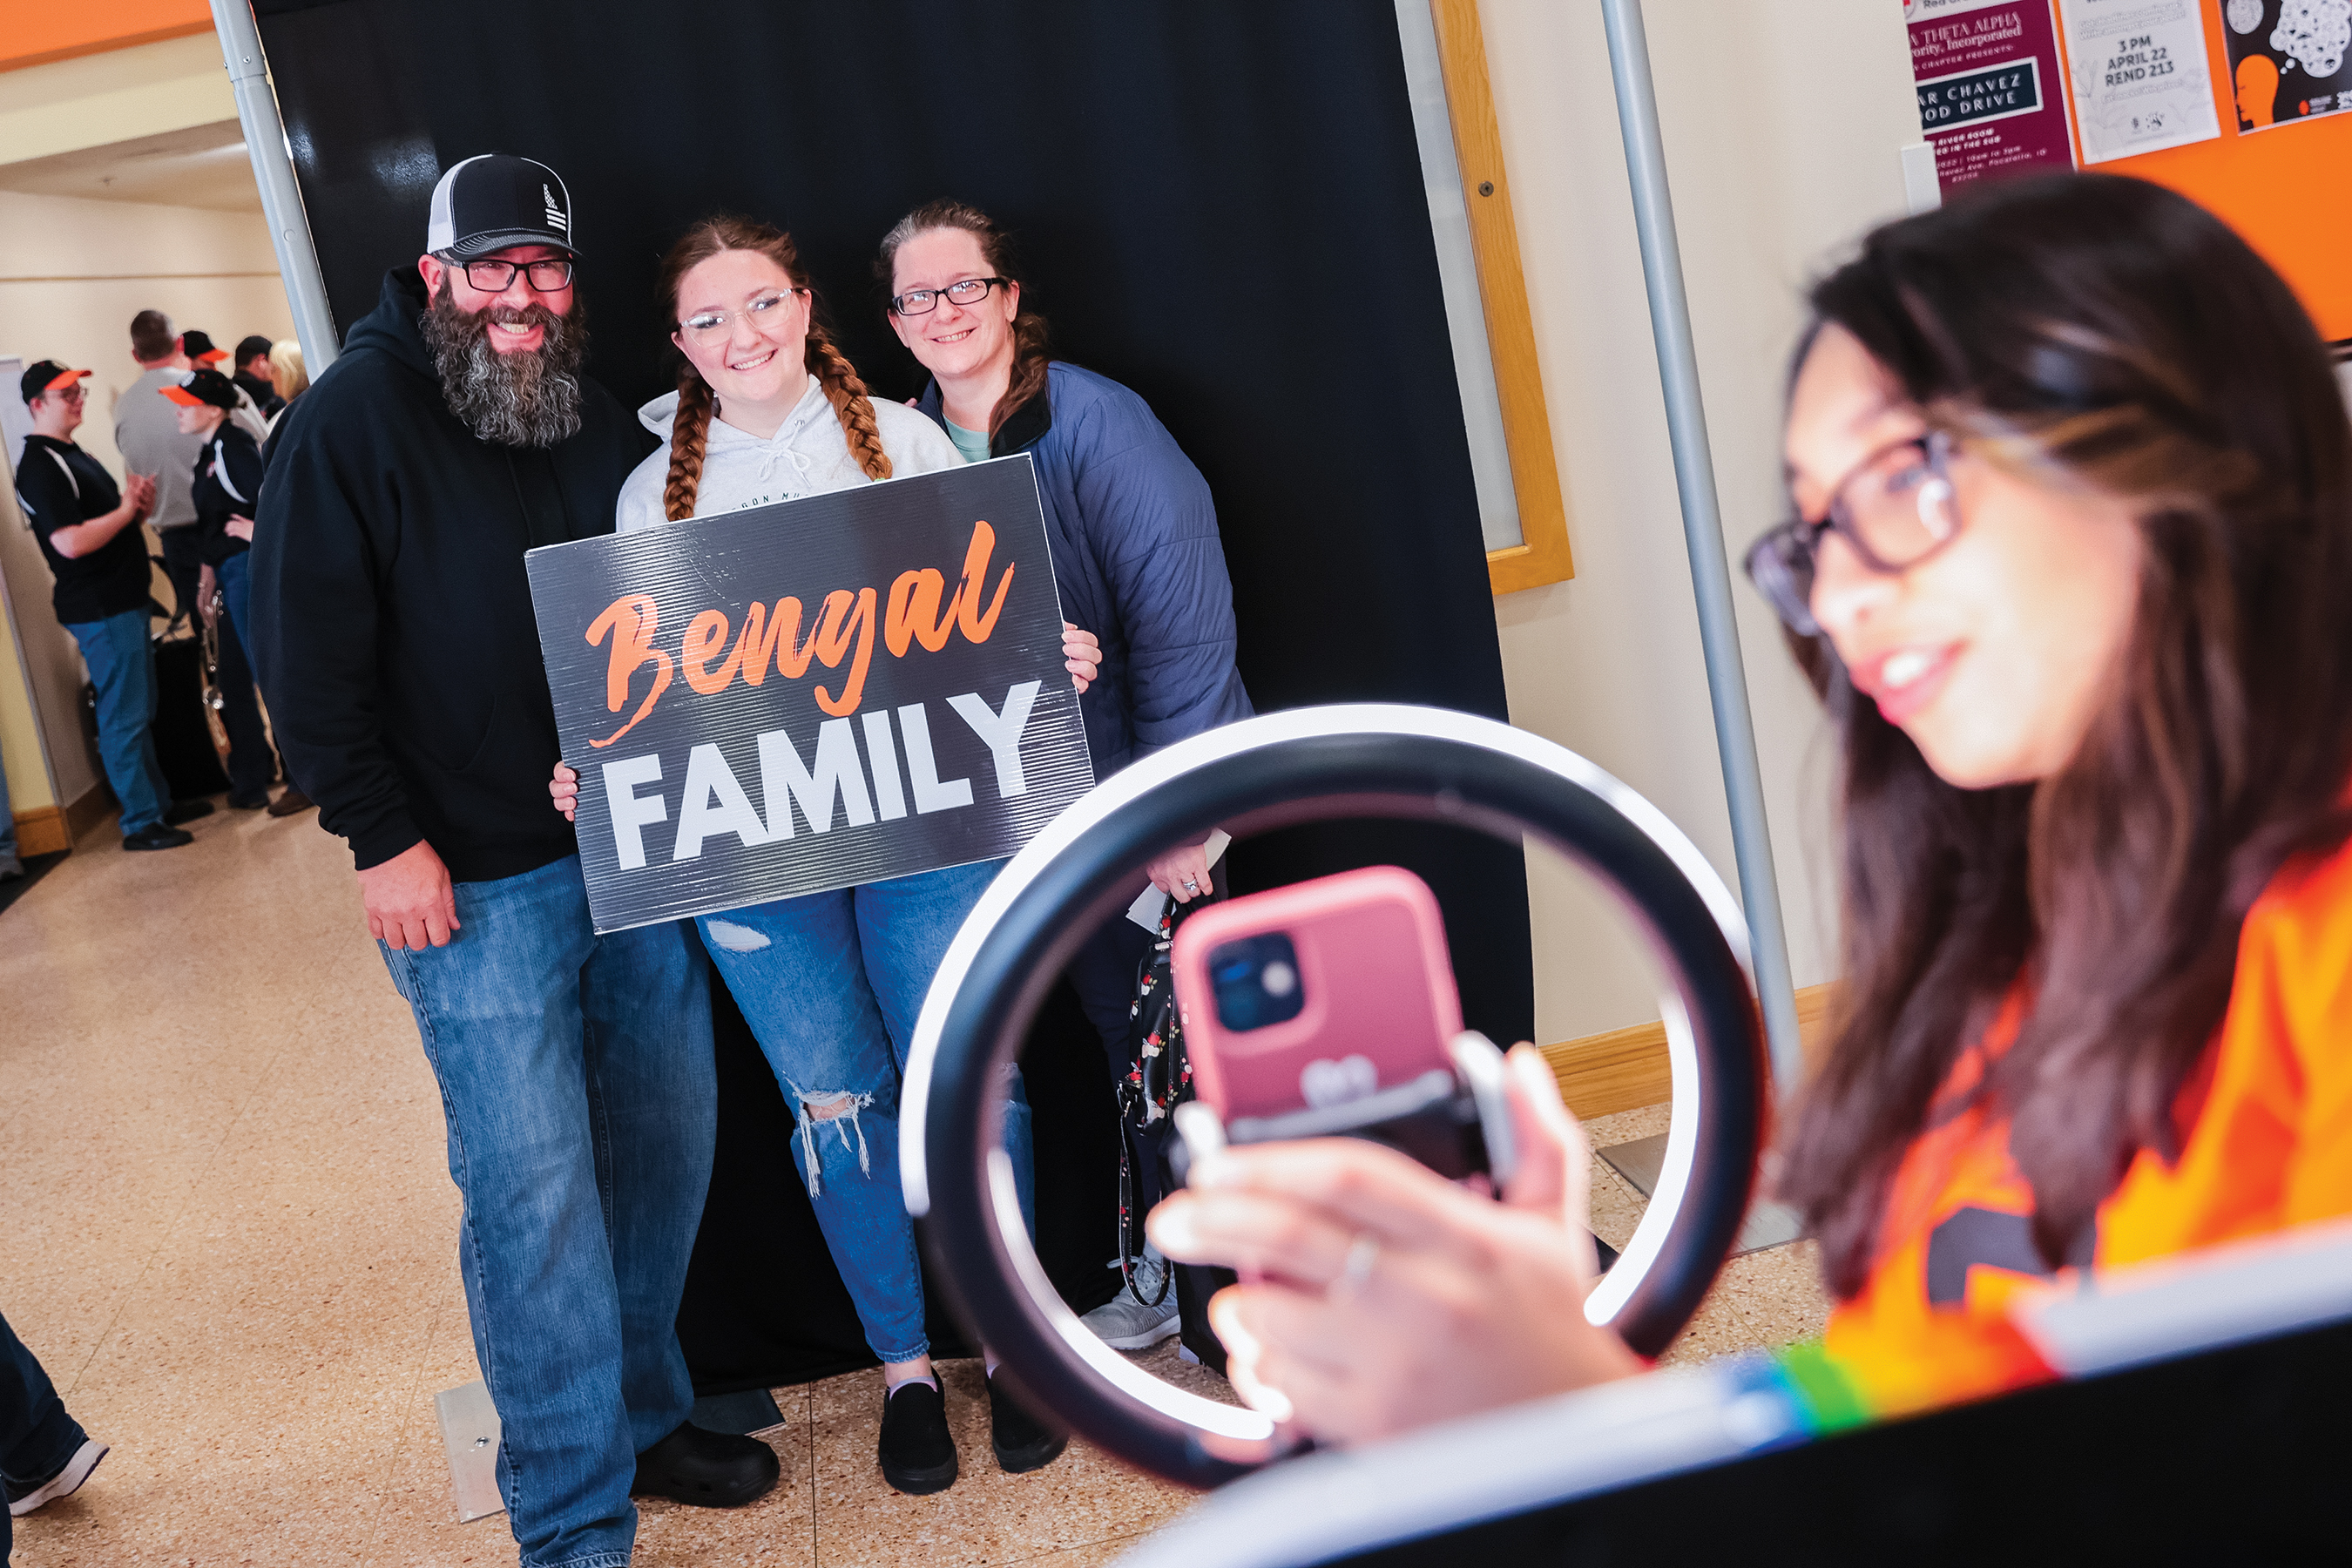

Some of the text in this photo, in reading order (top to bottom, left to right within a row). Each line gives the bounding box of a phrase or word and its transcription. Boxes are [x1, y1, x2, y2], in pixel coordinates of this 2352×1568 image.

[1921, 22, 1970, 44] THETA
[1974, 11, 2022, 33] ALPHA
[1946, 24, 2023, 51] Incorporated
[2118, 36, 2152, 52] 3 PM
[1921, 55, 1963, 70] CHAPTER
[2107, 47, 2167, 71] APRIL 22
[1946, 73, 2020, 99] CHAVEZ
[2105, 60, 2174, 87] REND 213
[1960, 91, 2017, 114] DRIVE
[1937, 132, 1965, 146] RIVER
[1967, 127, 1995, 142] ROOM
[585, 520, 1015, 747] Bengal
[602, 679, 1042, 870] FAMILY
